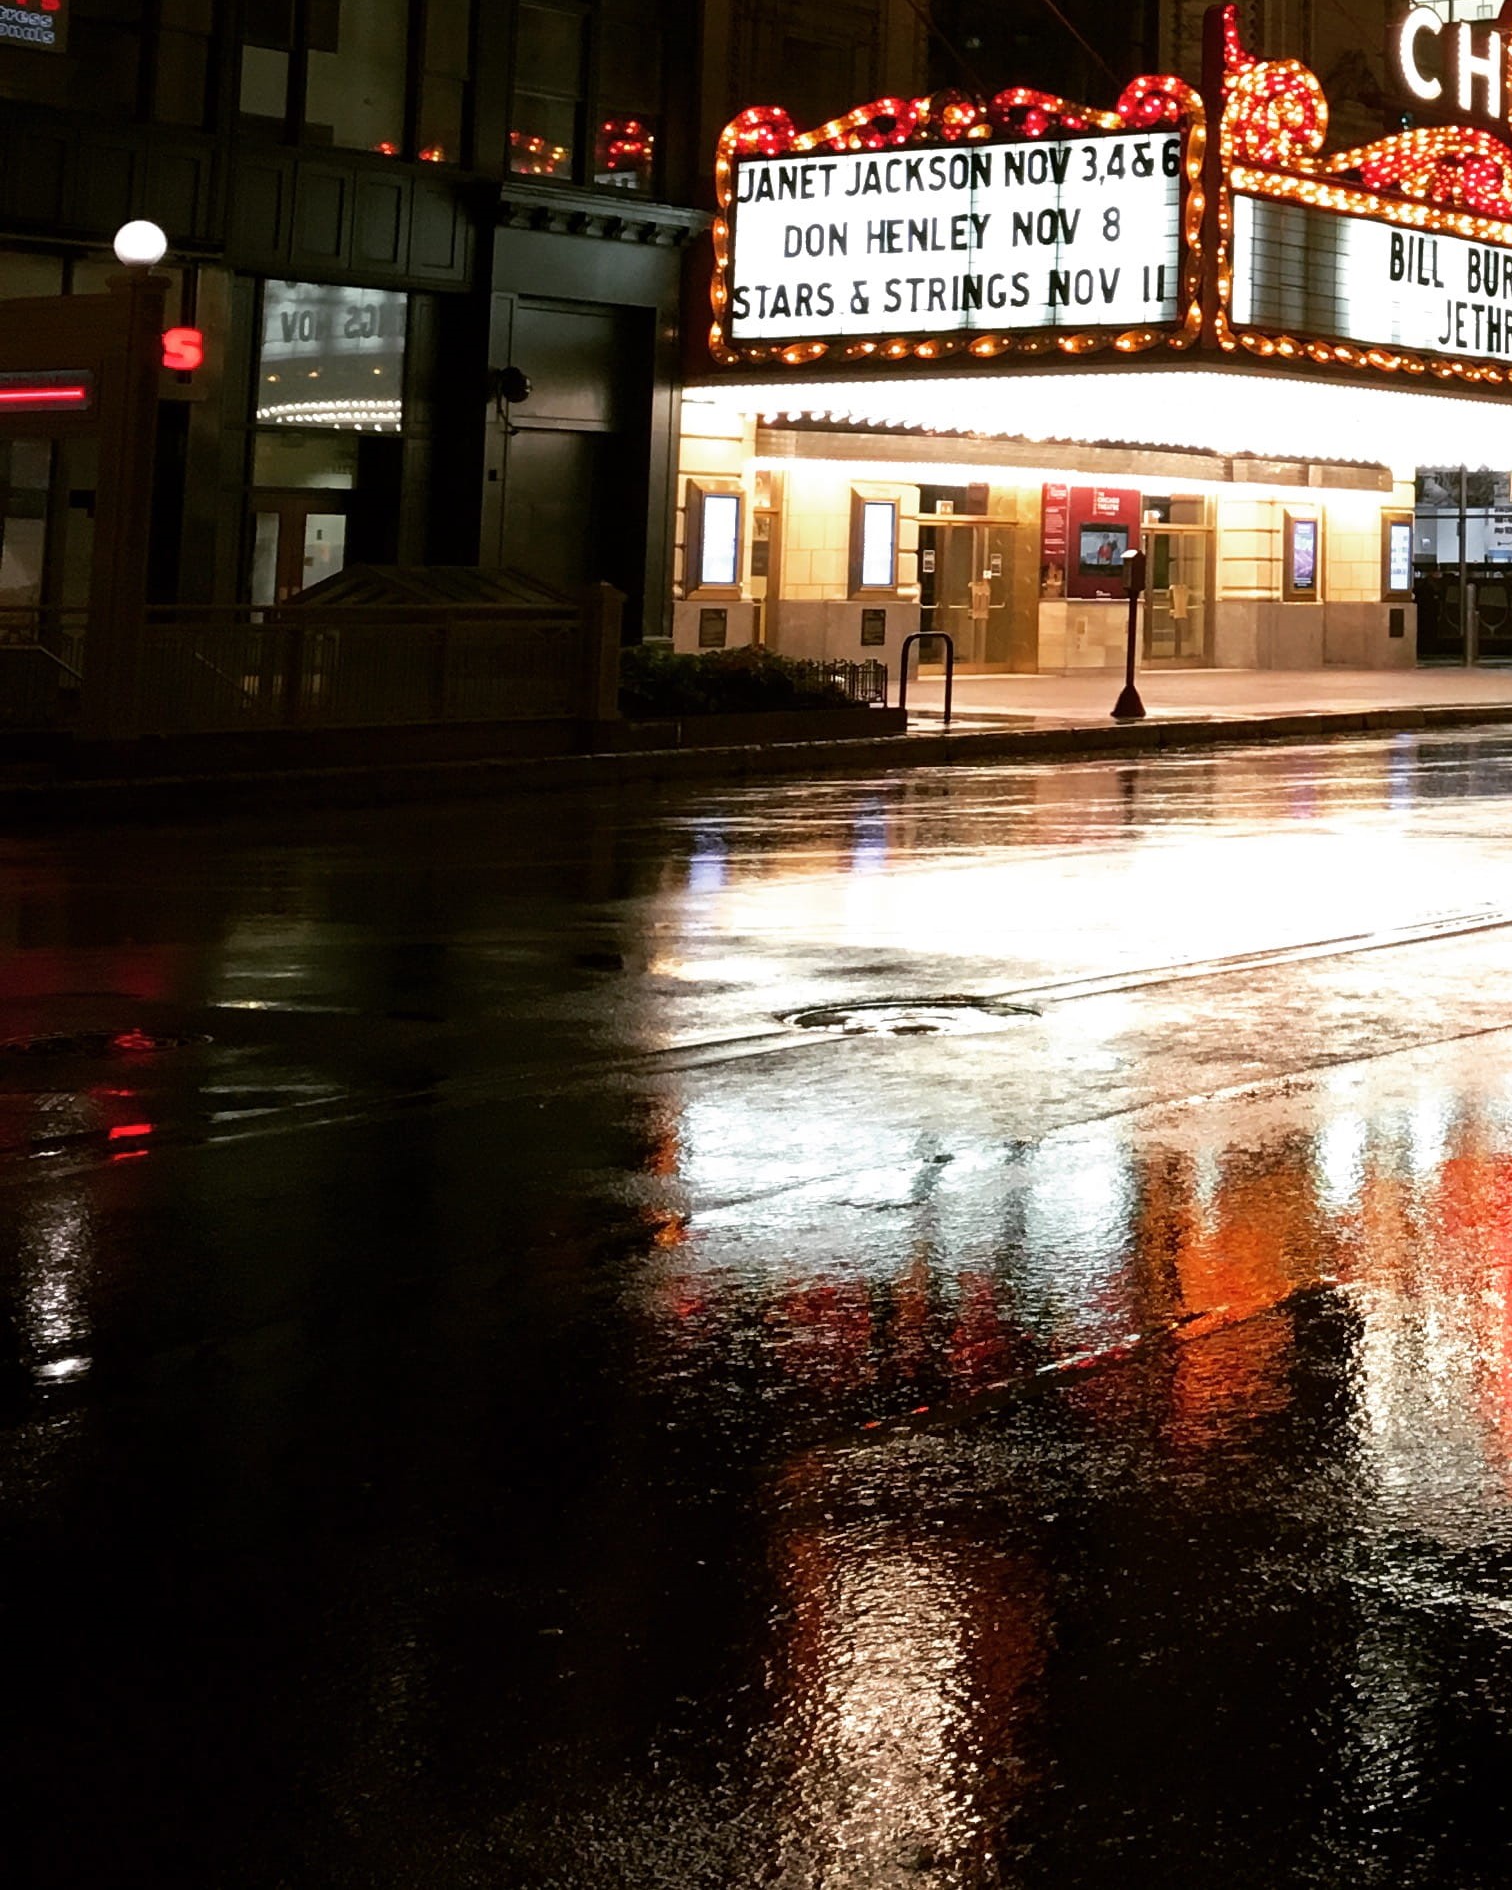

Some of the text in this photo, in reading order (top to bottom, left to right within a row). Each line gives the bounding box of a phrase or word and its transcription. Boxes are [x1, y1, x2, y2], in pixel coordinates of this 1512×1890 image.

[737, 163, 838, 203] JANET
[844, 152, 992, 197] JACKSON
[1004, 146, 1072, 188] NOV
[784, 206, 1121, 258] DON HENLEY NOV 8
[1390, 231, 1444, 288] BILL
[732, 282, 835, 320] STARS
[850, 280, 870, 315] &
[883, 271, 1030, 313] STRINGS
[1048, 266, 1121, 308] NOV
